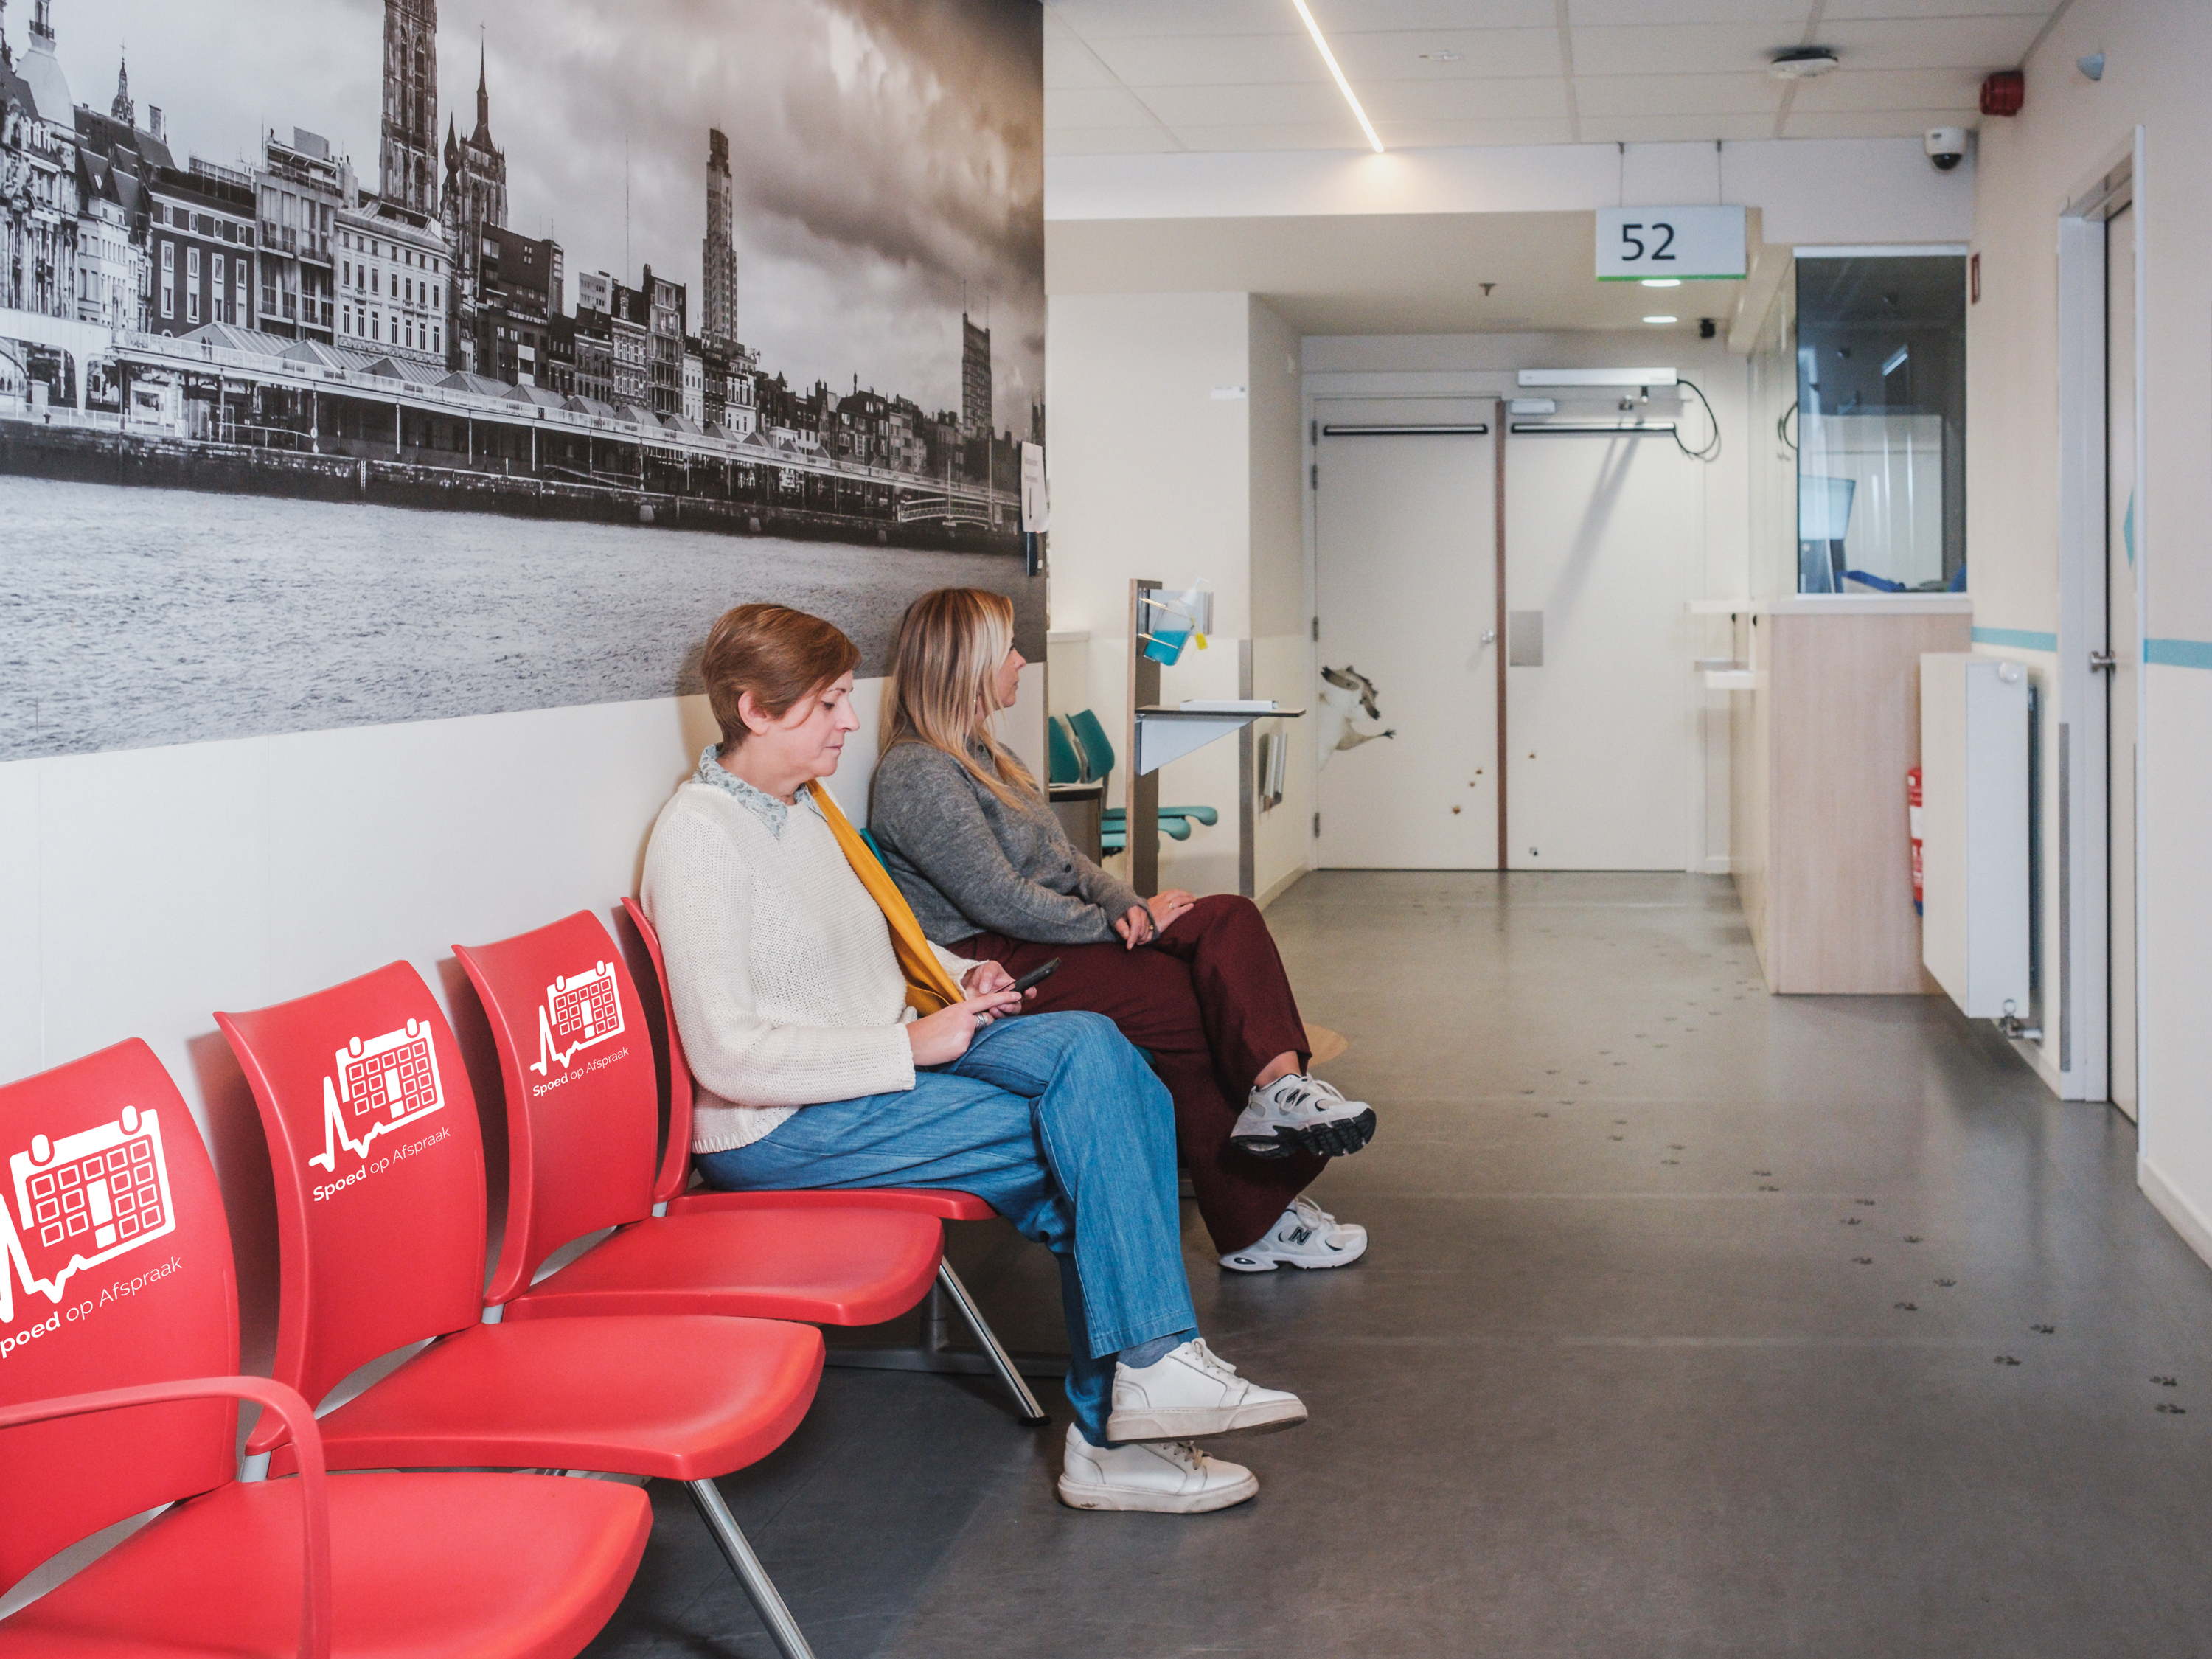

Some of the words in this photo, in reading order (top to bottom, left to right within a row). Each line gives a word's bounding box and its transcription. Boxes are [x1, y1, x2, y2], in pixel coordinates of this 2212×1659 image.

[1621, 223, 1676, 261] 52
[532, 1072, 568, 1096] Spoed
[571, 1068, 584, 1080] op
[586, 1046, 630, 1074] Afspraak
[313, 1164, 367, 1202] Spoed
[370, 1157, 389, 1174] op
[392, 1127, 451, 1164] Afspraak
[1287, 1226, 1312, 1246] N
[0, 1311, 61, 1359] poed
[66, 1300, 94, 1321] op
[99, 1256, 183, 1308] Afspraak
